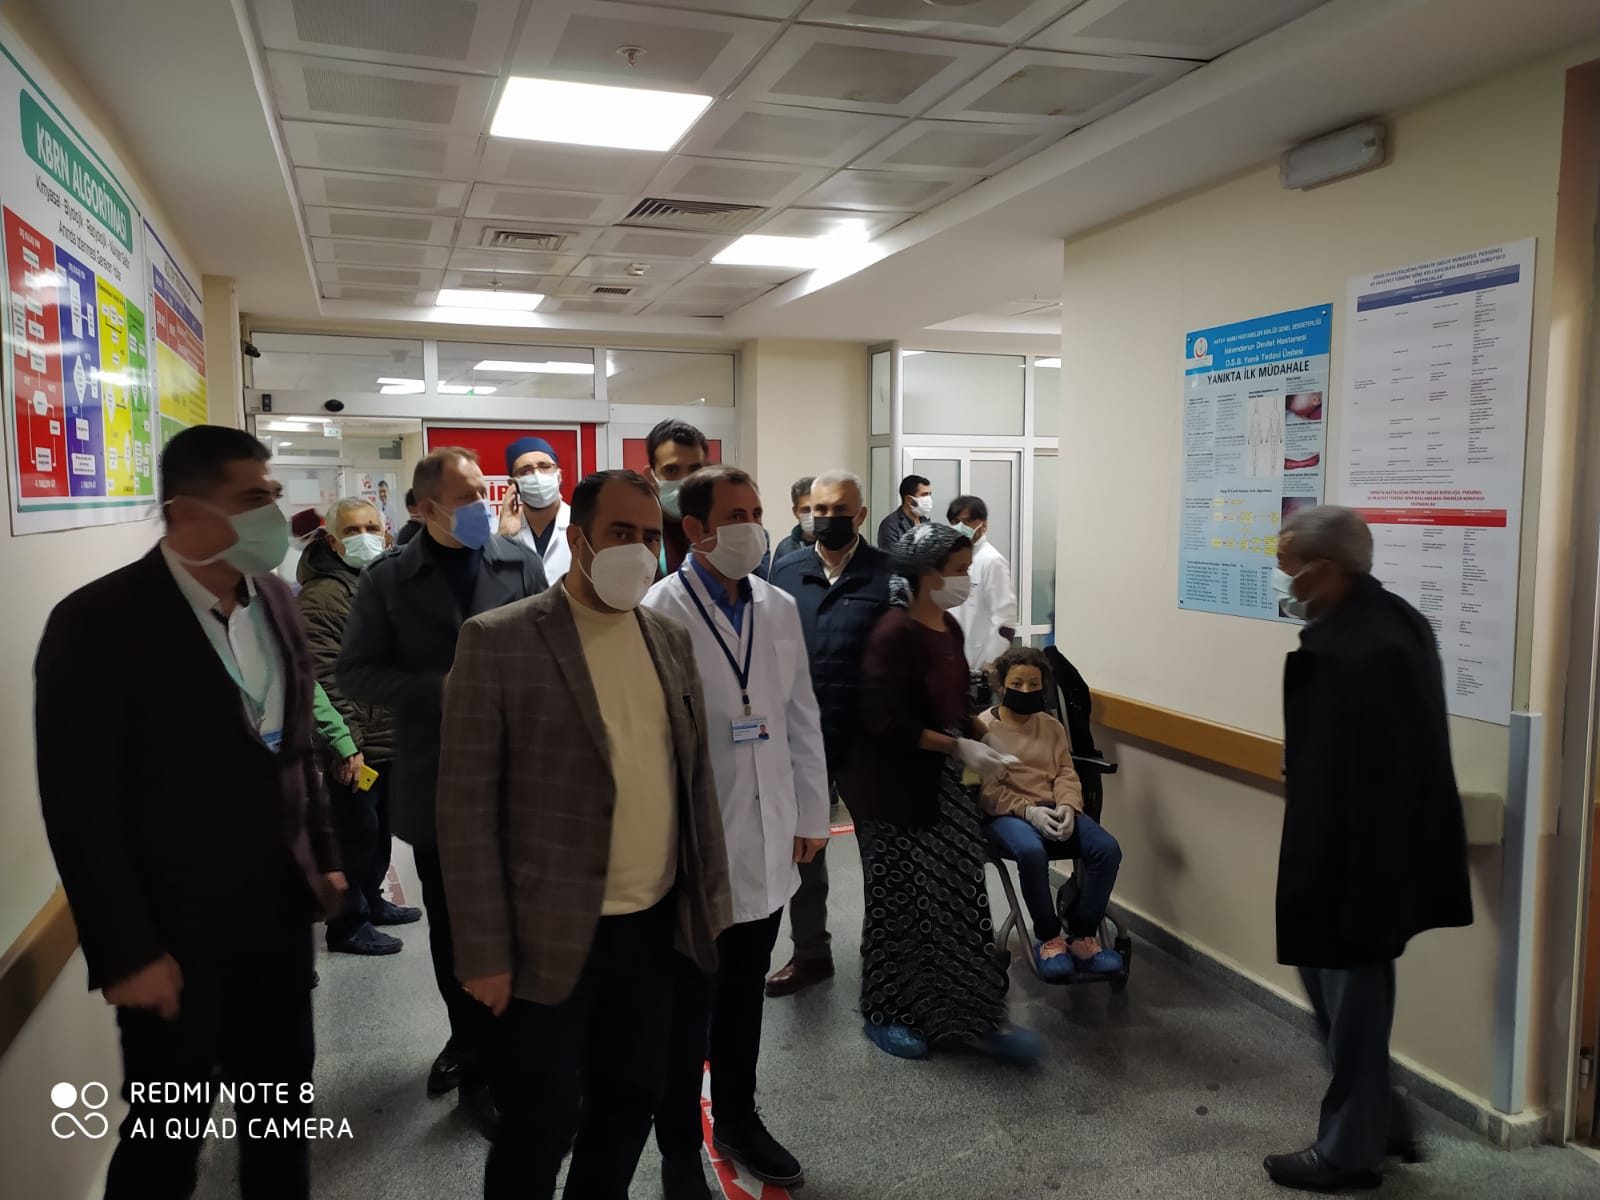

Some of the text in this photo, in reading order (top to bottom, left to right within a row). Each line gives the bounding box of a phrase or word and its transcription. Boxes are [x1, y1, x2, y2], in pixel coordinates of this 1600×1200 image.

[37, 121, 69, 186] KBRN
[72, 160, 127, 243] ALGORİTMASI
[1224, 334, 1307, 354] İskenderun Devlet Hastanesi
[1261, 352, 1281, 360] Tedavi
[1282, 348, 1304, 357] Ünitesi
[1208, 360, 1309, 384] YANIKTA İLK MÜDAHALE
